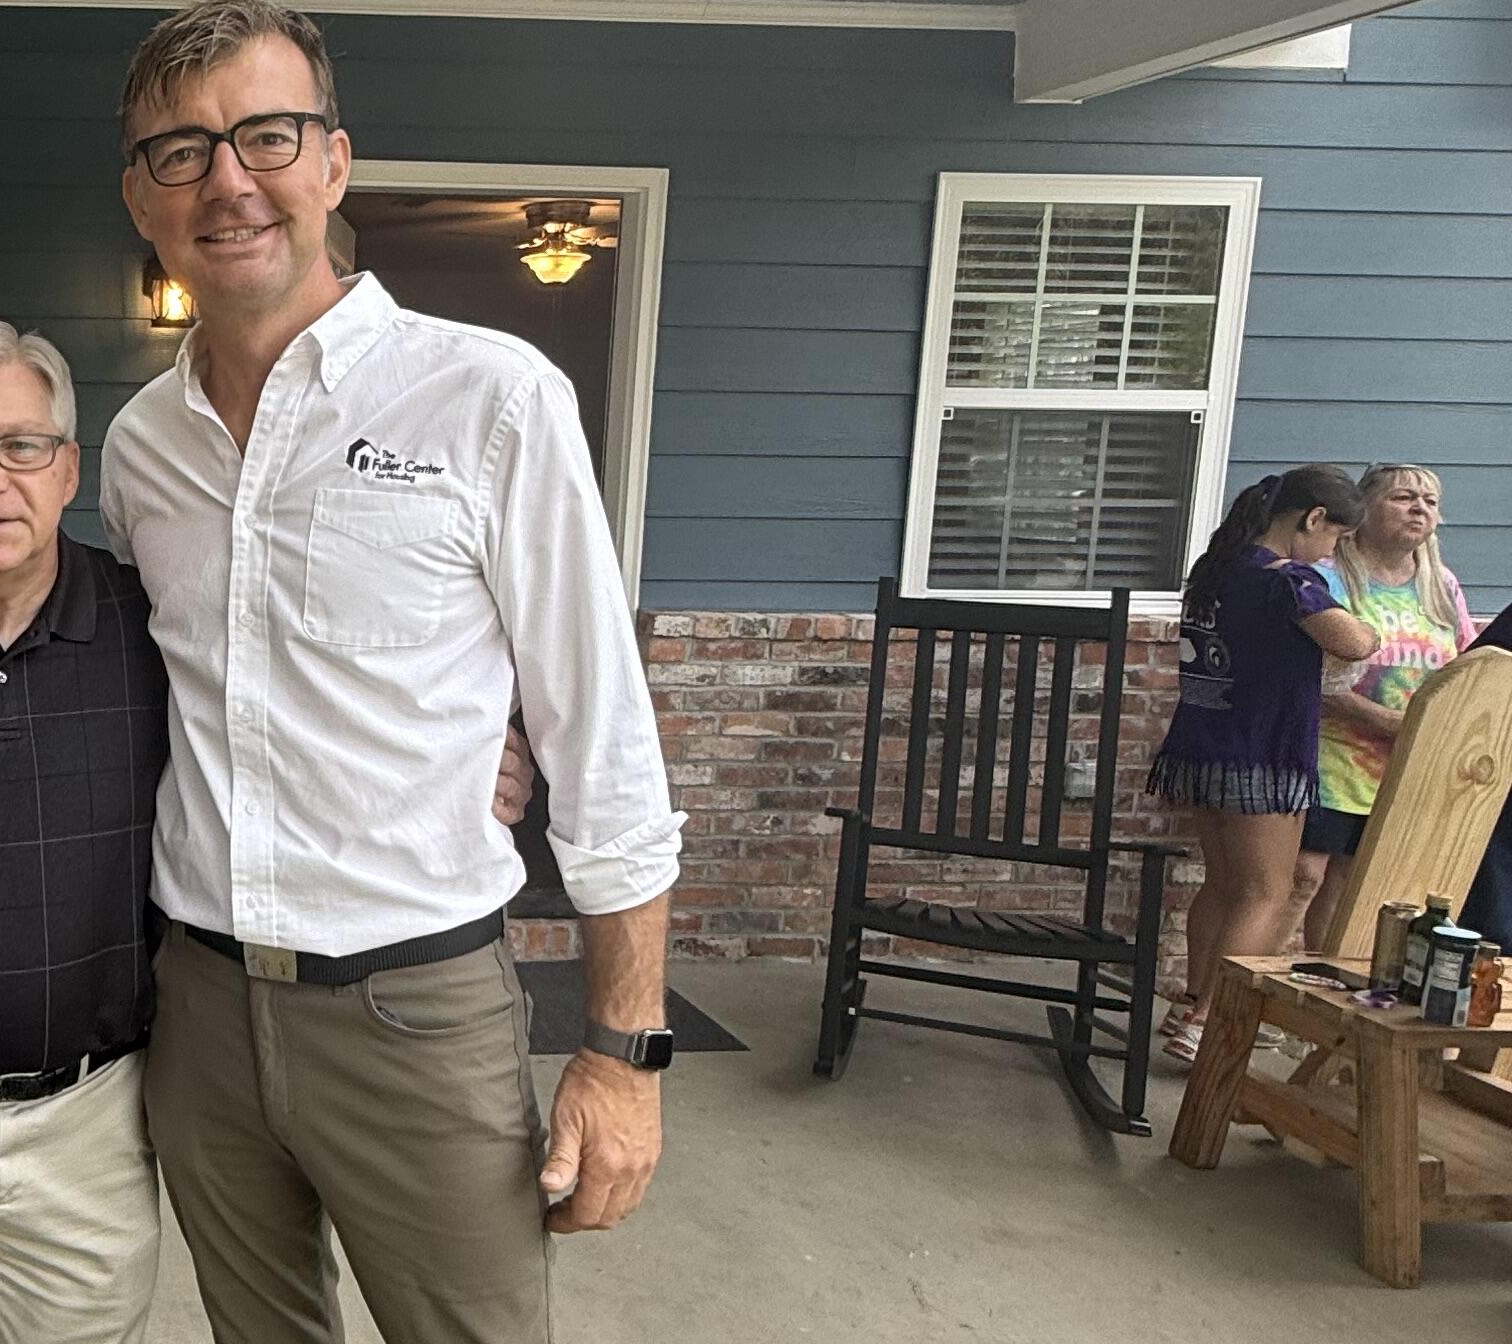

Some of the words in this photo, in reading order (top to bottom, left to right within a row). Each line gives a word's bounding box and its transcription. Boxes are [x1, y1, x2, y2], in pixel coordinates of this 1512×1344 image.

[372, 458, 402, 471] Fuller
[404, 460, 445, 475] Center
[1376, 605, 1420, 634] be
